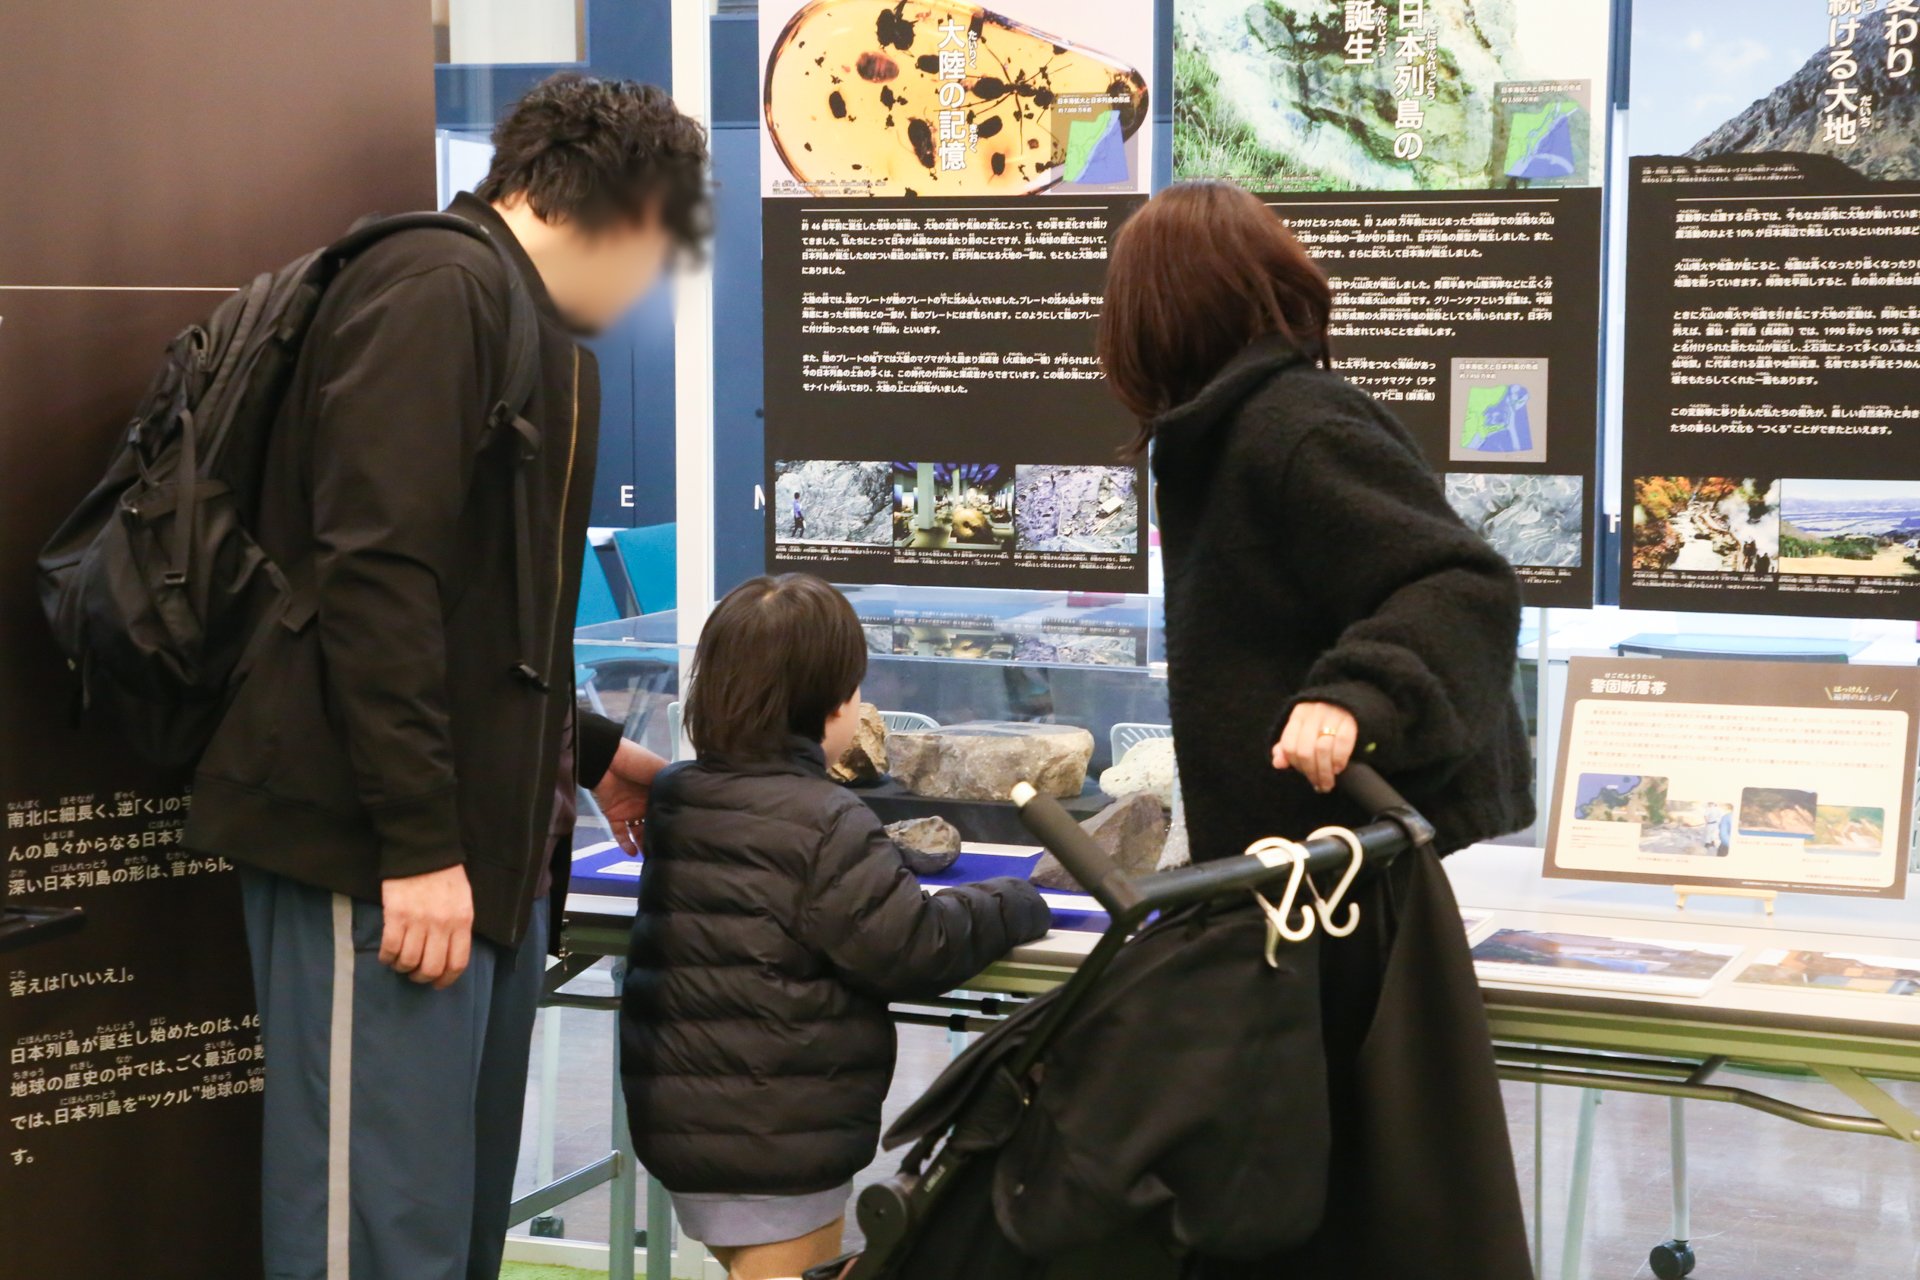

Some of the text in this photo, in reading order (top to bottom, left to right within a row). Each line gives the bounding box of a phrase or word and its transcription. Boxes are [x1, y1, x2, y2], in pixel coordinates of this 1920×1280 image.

[1344, 0, 1375, 65] 誕生
[968, 30, 978, 69] たいりく
[937, 19, 967, 171] 大陸の記憶
[1393, 0, 1425, 160] 日本列島の
[801, 267, 846, 275] にありました。
[1328, 327, 1456, 336] 地に残されていることを意味します。
[620, 485, 635, 507] E
[10, 967, 135, 997] 答えは「いいえ」。
[10, 1149, 34, 1166] す。
